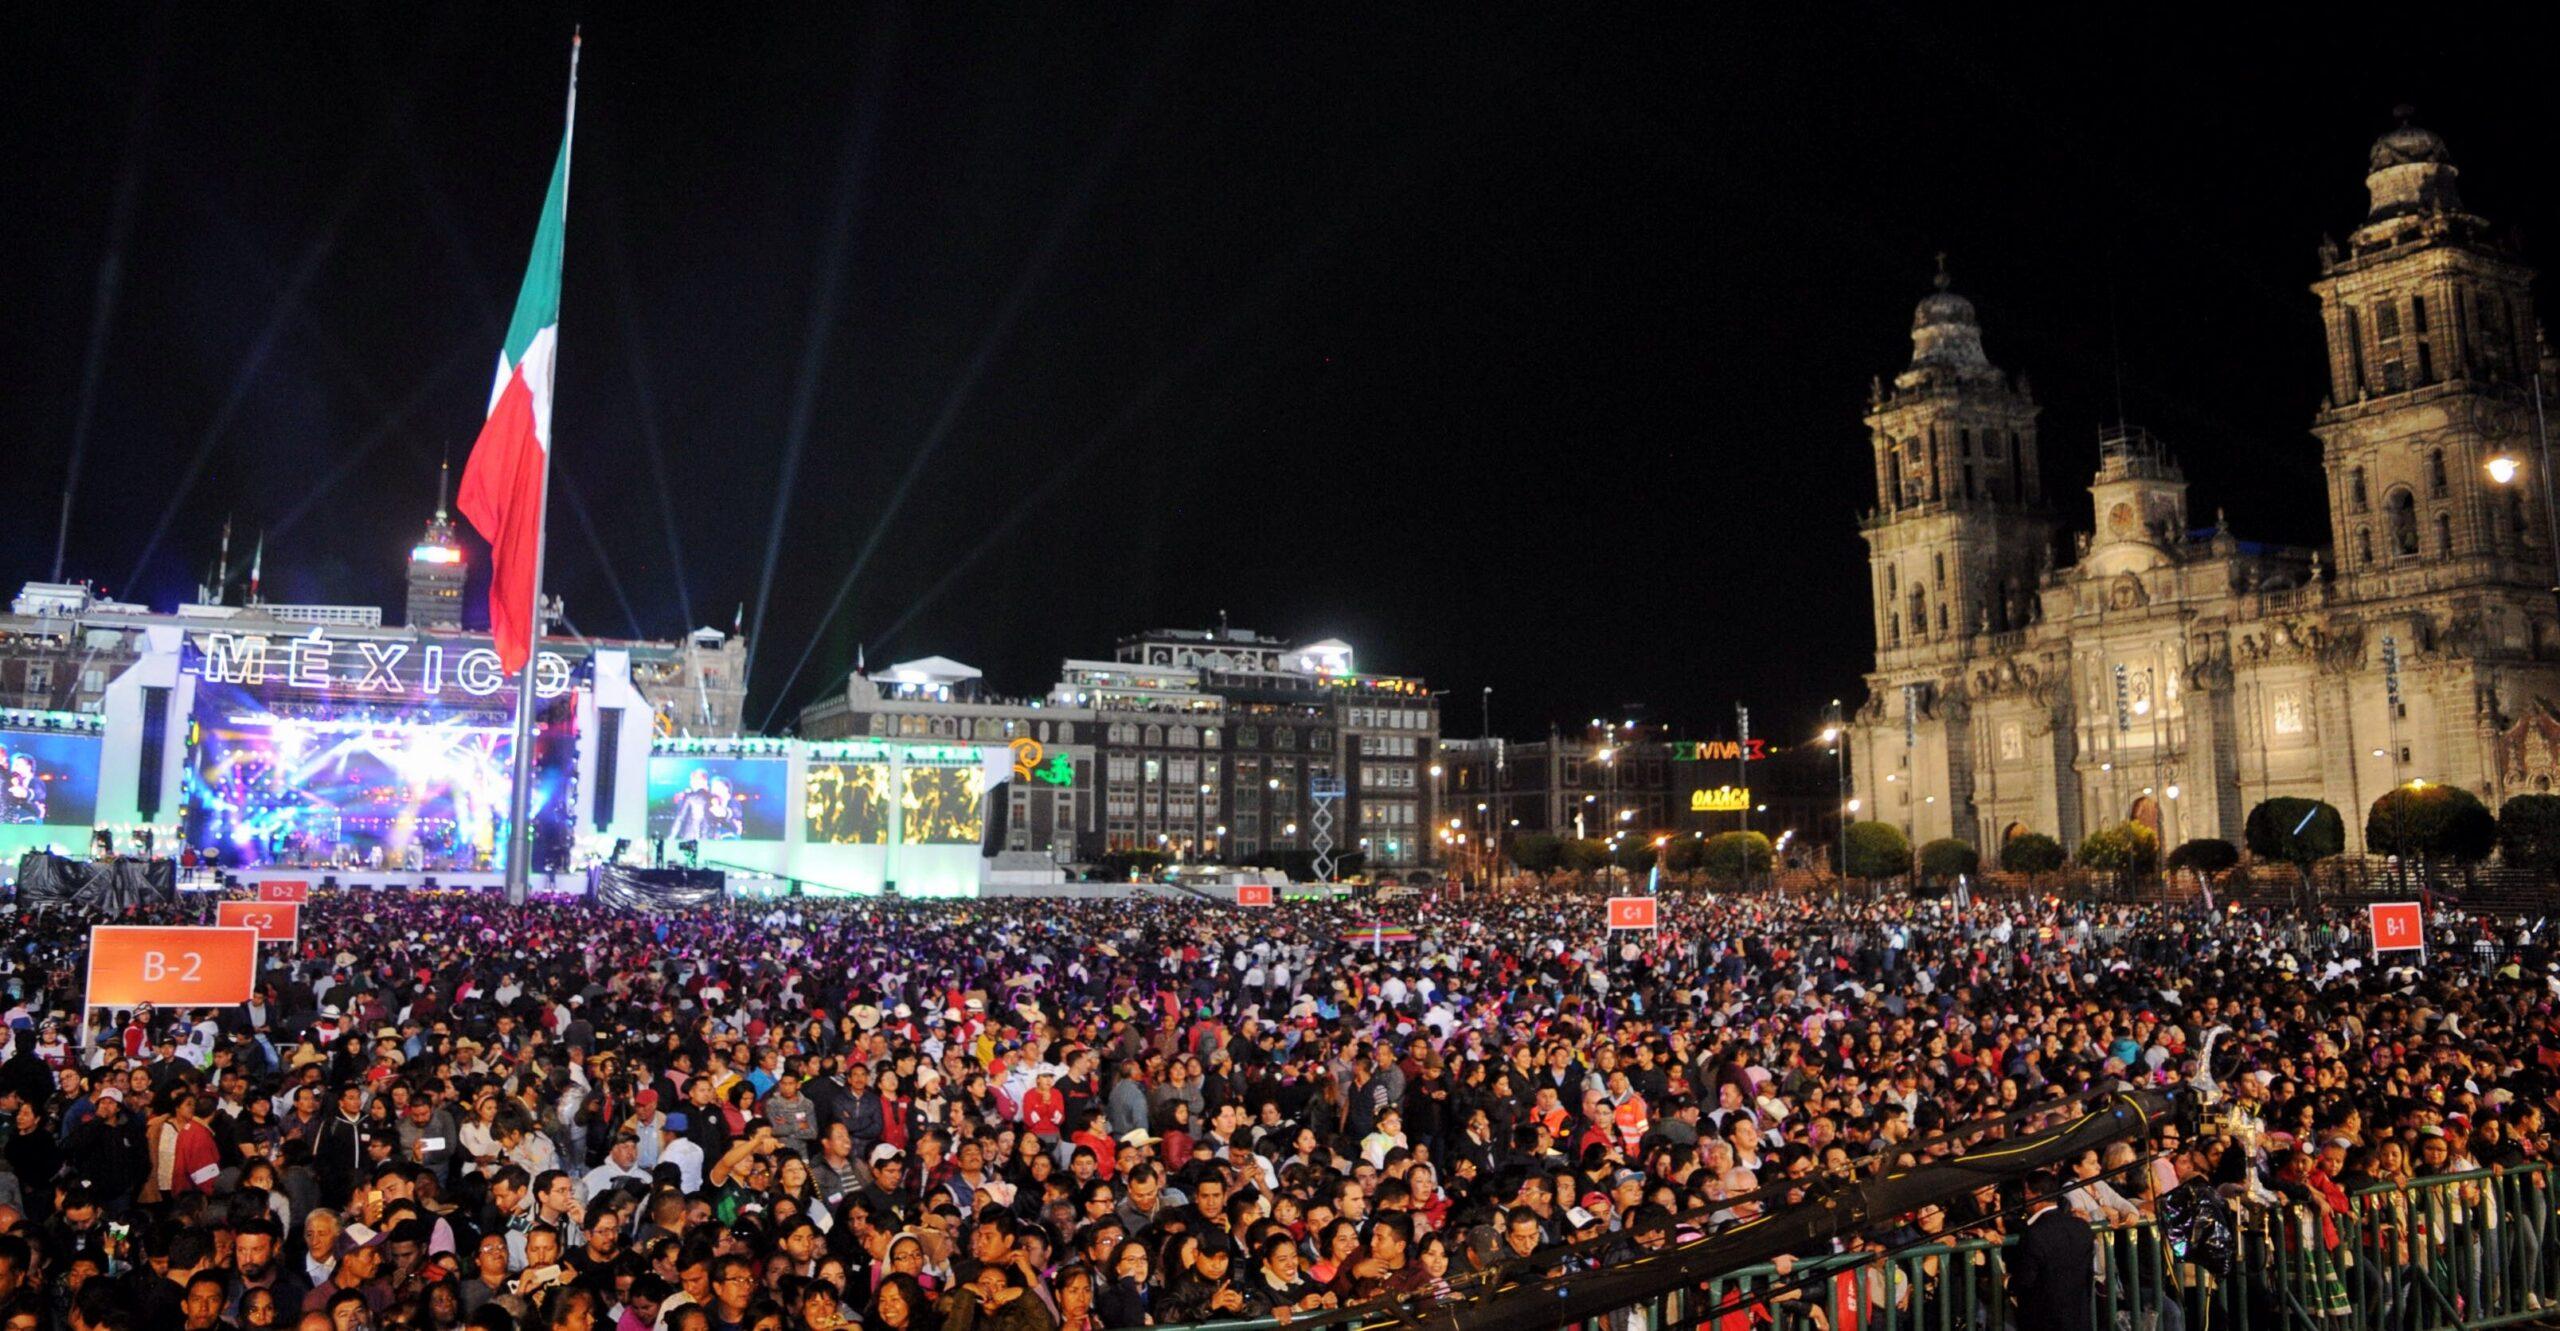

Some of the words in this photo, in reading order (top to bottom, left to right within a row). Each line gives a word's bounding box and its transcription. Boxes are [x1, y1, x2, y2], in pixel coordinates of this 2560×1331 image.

[204, 627, 571, 698] MÉXICO
[1691, 788, 1749, 809] OAXACA
[272, 886, 294, 897] D-2
[1247, 890, 1262, 900] D-1
[1623, 906, 1642, 920] C-1
[243, 914, 273, 930] C-2
[2386, 917, 2405, 936] B-1
[143, 951, 202, 982] B-2
